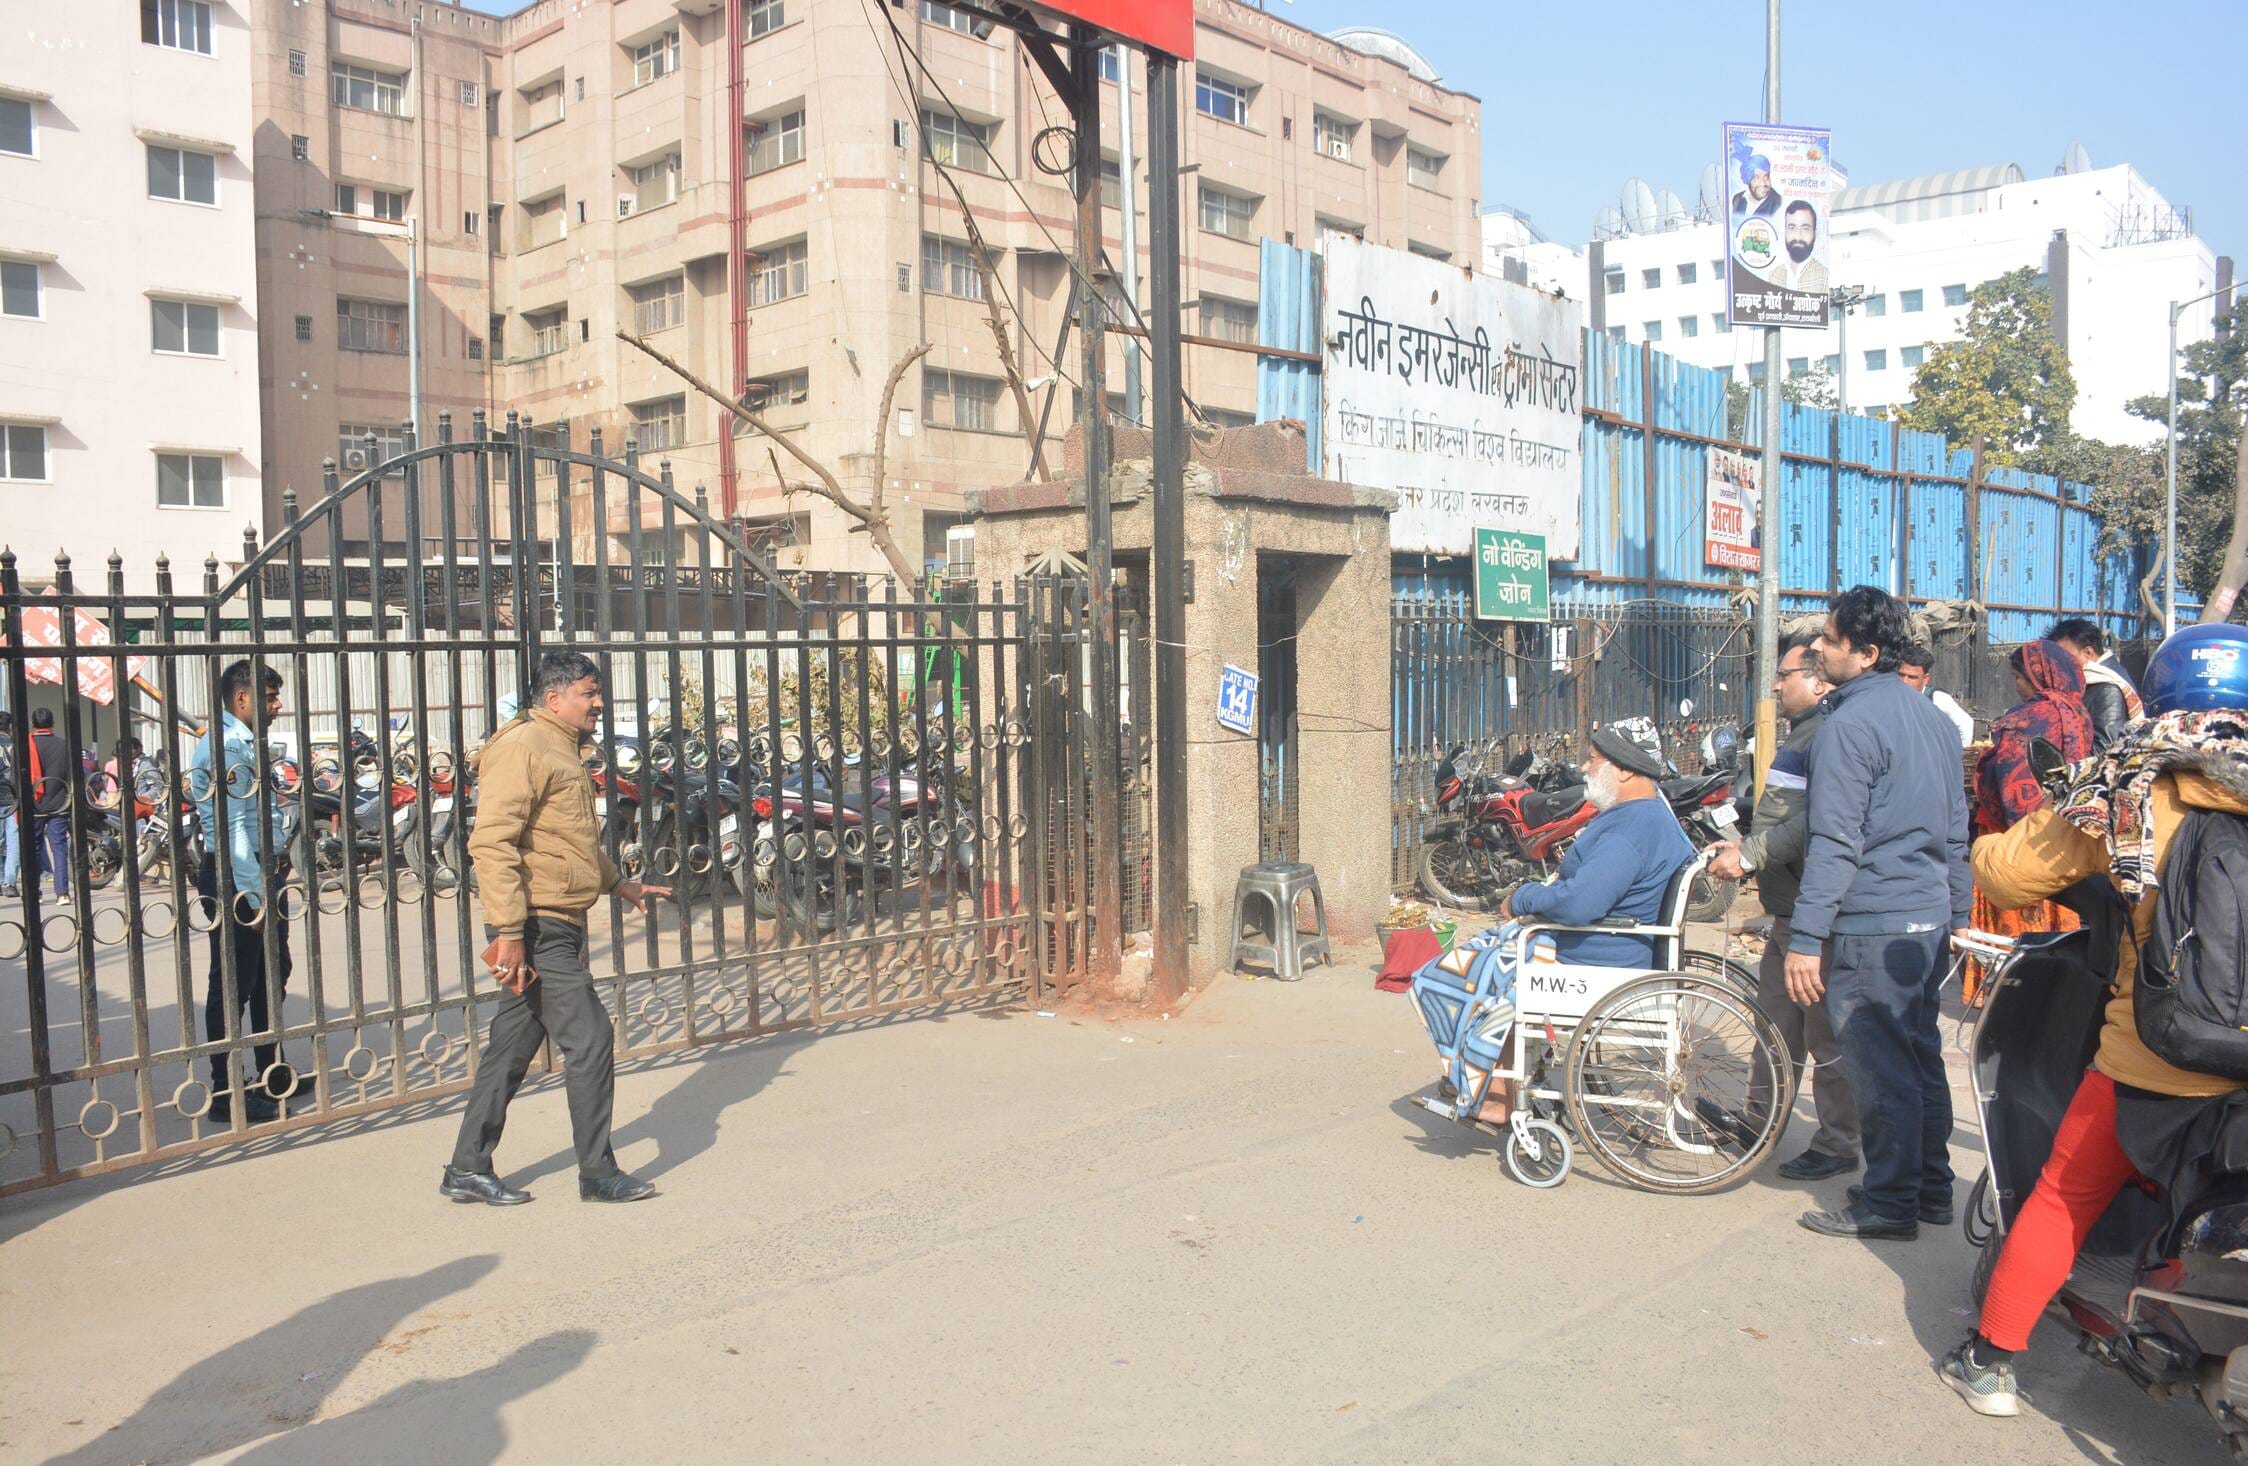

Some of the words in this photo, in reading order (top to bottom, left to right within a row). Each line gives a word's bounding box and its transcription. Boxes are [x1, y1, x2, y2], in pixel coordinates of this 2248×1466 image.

[1764, 291, 1782, 310] मौर्य
[1338, 296, 1392, 375] नवीन
[1540, 342, 1576, 415] सेन्टर
[1338, 398, 1374, 447] किंग
[1411, 408, 1469, 458] चिकित्सा
[1509, 428, 1571, 472] विद्यालय
[1711, 500, 1744, 536] अलाव
[1482, 535, 1499, 566] नो
[1501, 536, 1542, 571] वेन्डिंग
[1226, 684, 1248, 714] 14
[1220, 707, 1250, 726] KGMU
[1530, 976, 1588, 994] M.W.-3
